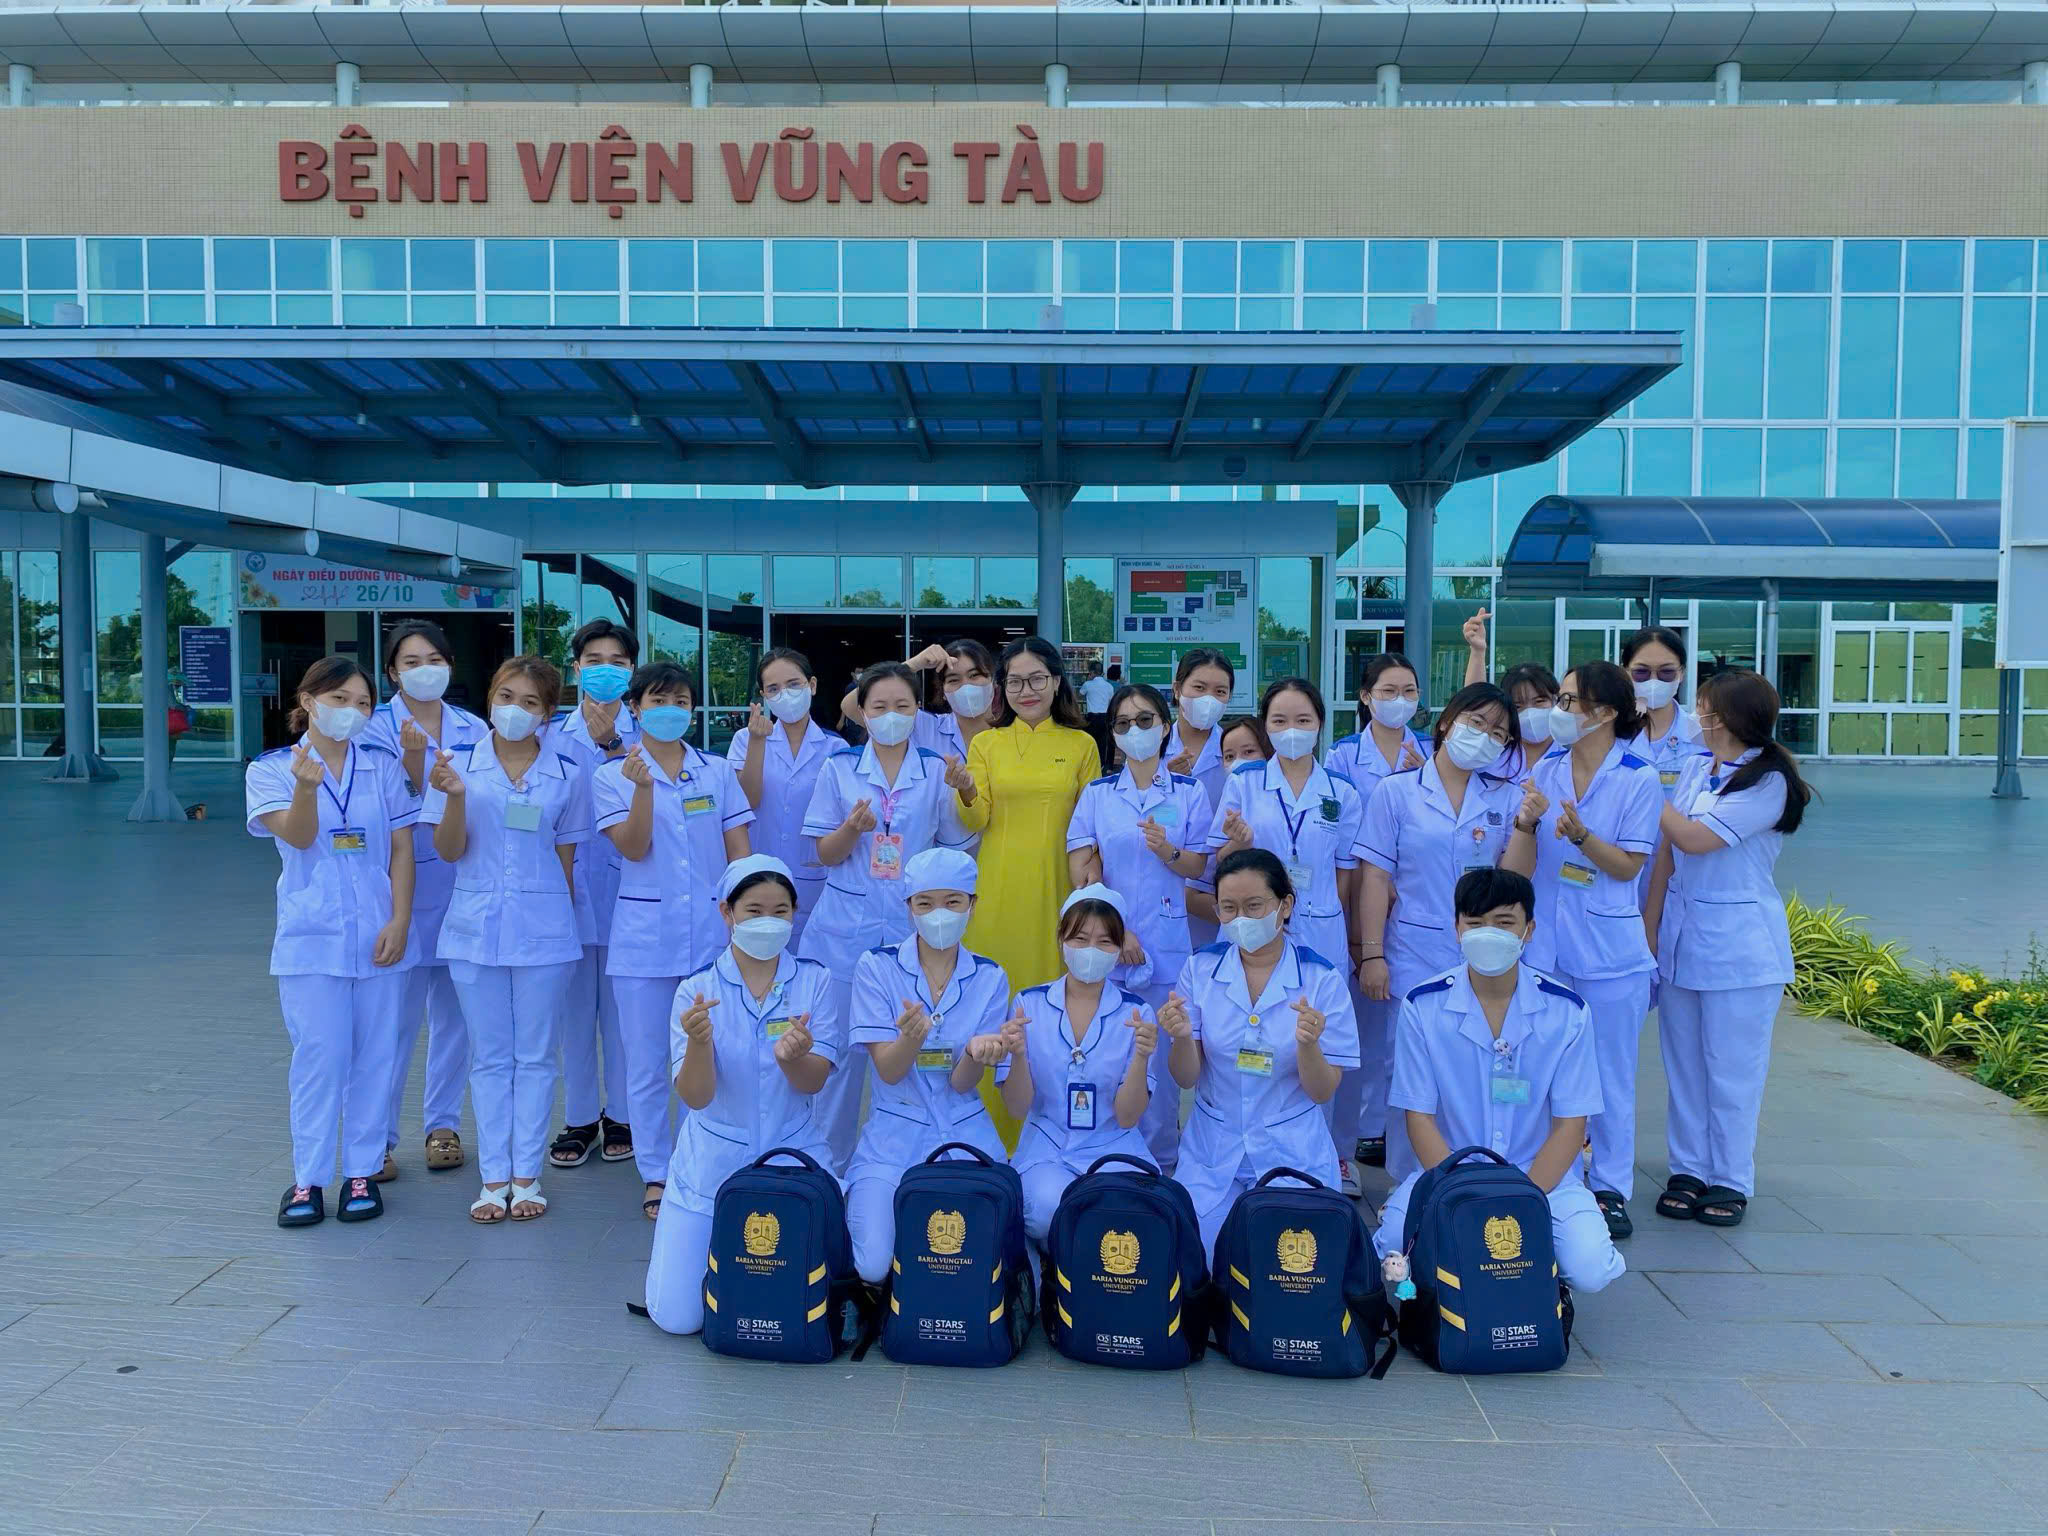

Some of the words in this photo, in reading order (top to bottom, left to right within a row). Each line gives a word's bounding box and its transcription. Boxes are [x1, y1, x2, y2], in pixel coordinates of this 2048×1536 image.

[278, 123, 489, 219] BỆNH
[515, 123, 695, 219] VIỆN
[719, 126, 930, 205] VŨNG
[953, 124, 1106, 205] TÀU
[272, 568, 304, 581] NGÀY
[356, 585, 414, 602] 26/10
[735, 1256, 754, 1264] BARIA
[754, 1258, 787, 1266] VUNGTAU
[918, 1255, 938, 1263] BARIA
[938, 1257, 973, 1265] VUNGTAU
[1479, 1262, 1502, 1271] BARIA
[1502, 1260, 1534, 1269] VUNGTAU
[1091, 1274, 1113, 1282] BARIA
[1113, 1276, 1148, 1285] VUNGTAU
[1268, 1274, 1290, 1282] BARIA
[1290, 1275, 1326, 1283] VUNGTAU
[738, 1319, 749, 1329] QS
[752, 1319, 779, 1329] STARS
[920, 1319, 932, 1329] QS
[935, 1319, 964, 1329] STARS
[1493, 1328, 1505, 1338] QS
[1507, 1325, 1535, 1335] STARS
[1097, 1334, 1109, 1343] QS
[1112, 1335, 1141, 1345] STARS
[1274, 1339, 1286, 1349] QS
[1289, 1339, 1319, 1350] STARS
